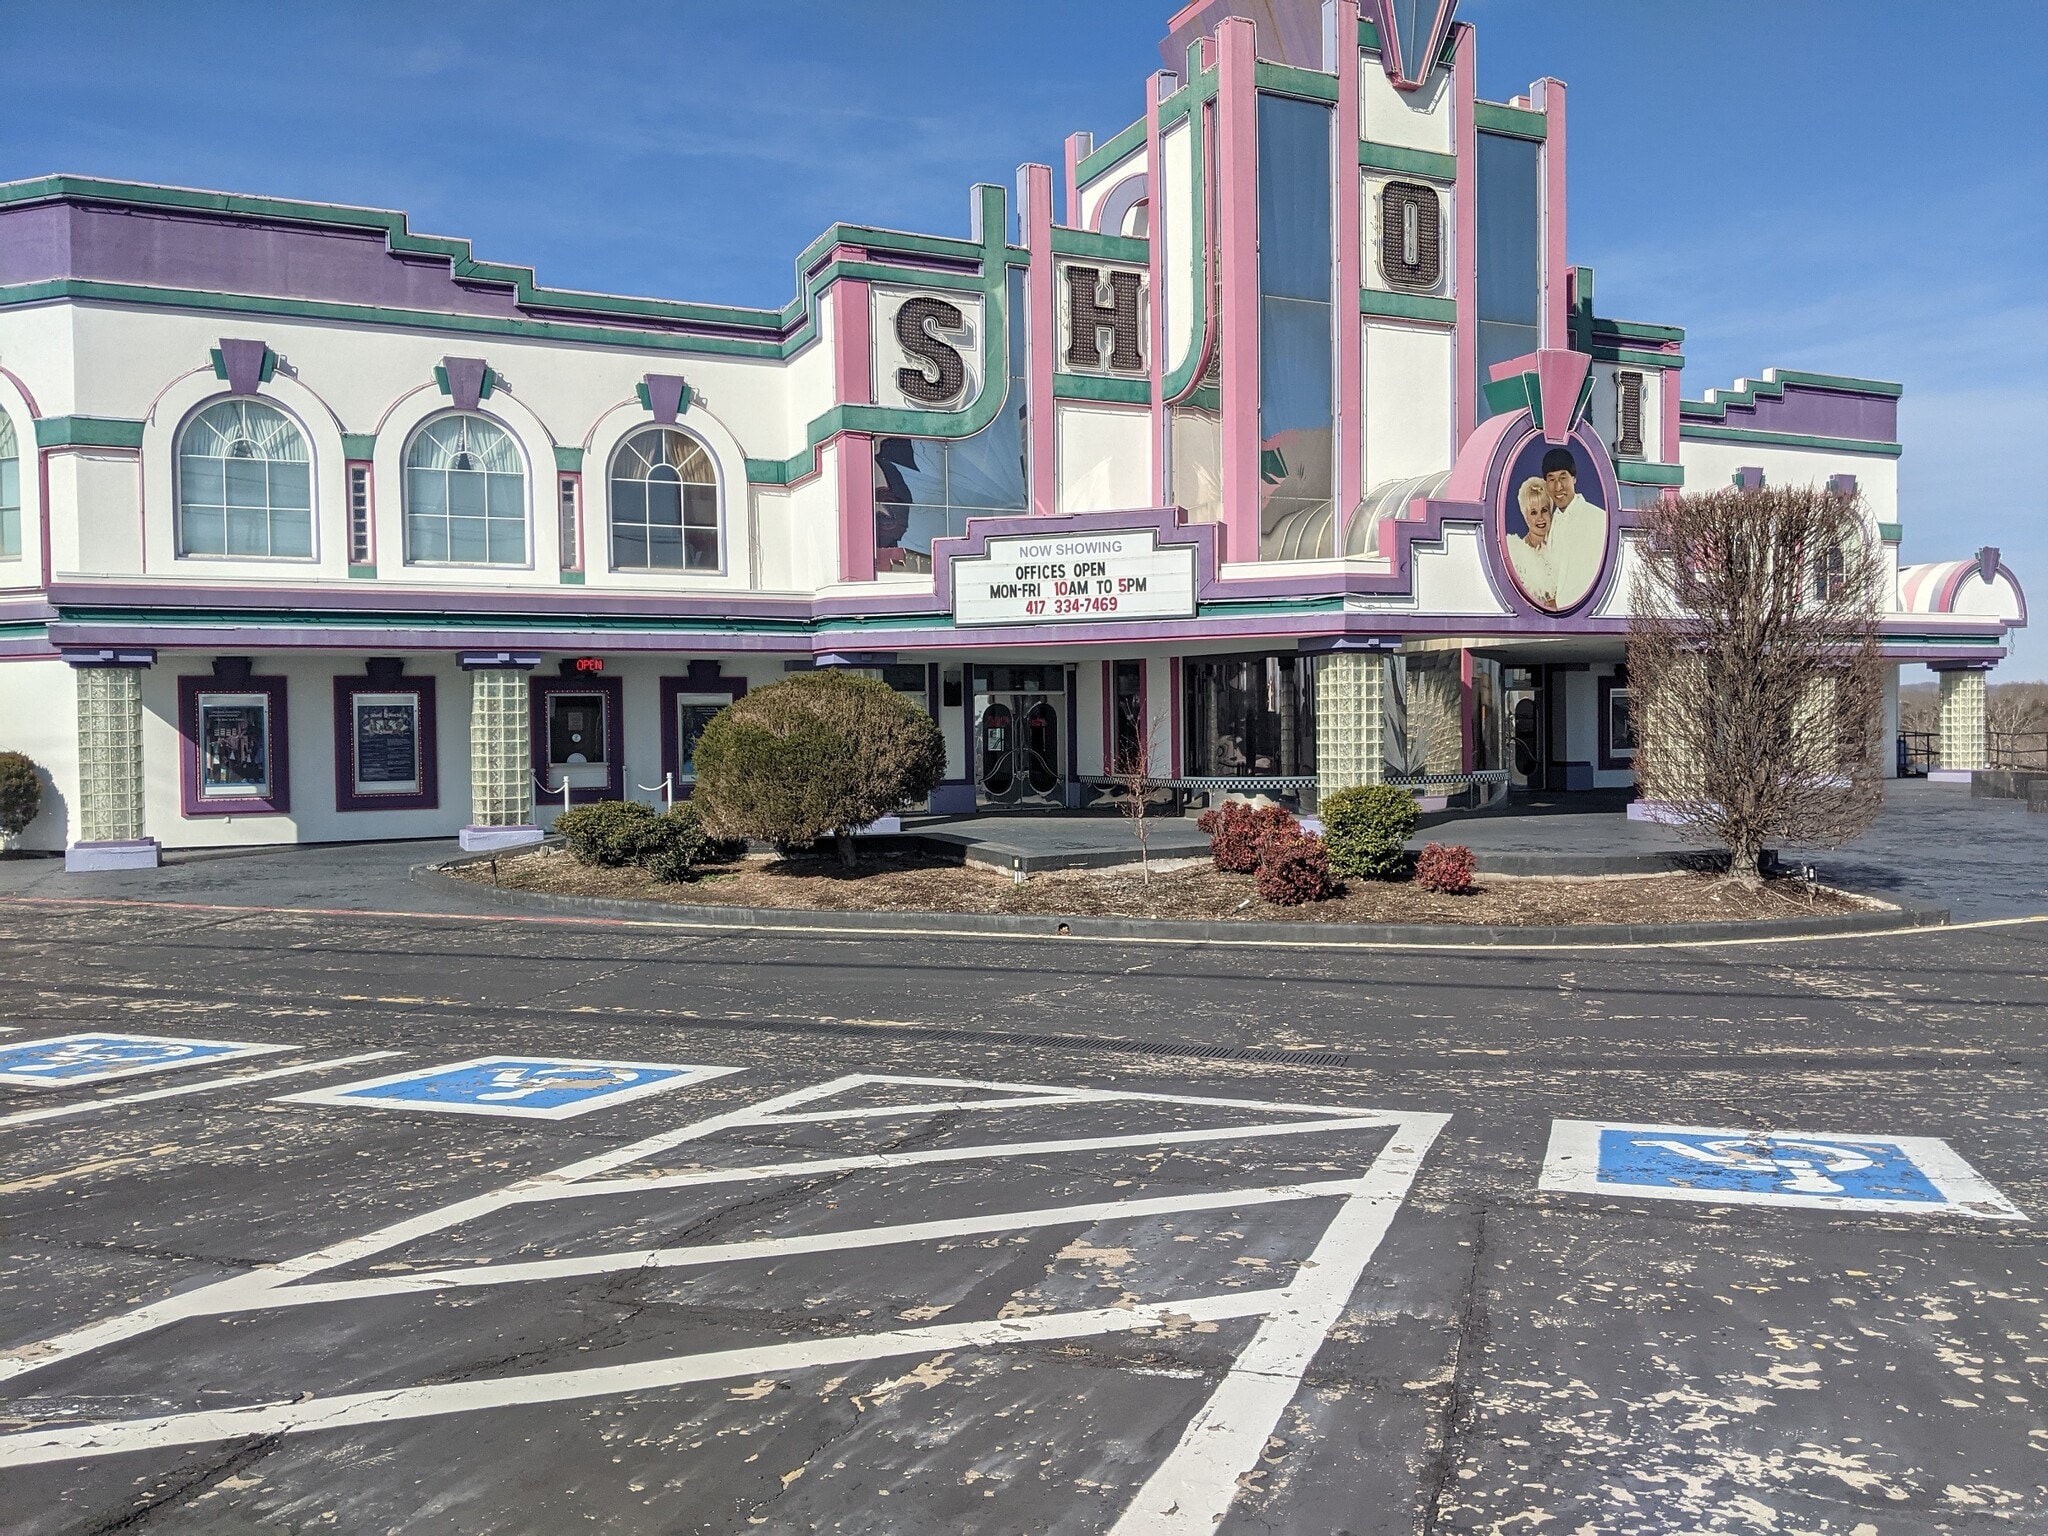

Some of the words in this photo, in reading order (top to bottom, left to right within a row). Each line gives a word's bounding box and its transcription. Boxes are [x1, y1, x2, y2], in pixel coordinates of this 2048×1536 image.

[1019, 545, 1052, 558] NOW
[1055, 540, 1122, 556] SHOWING
[1016, 564, 1065, 580] OFFICES
[1073, 562, 1106, 577] OPEN
[990, 582, 1041, 599] MON-FRI
[1054, 580, 1088, 596] 10AM
[1096, 579, 1112, 594] TO
[1118, 577, 1147, 593] 5PM
[1025, 600, 1045, 615] 417
[1054, 596, 1118, 614] 334-7469
[576, 659, 603, 671] OPEN
